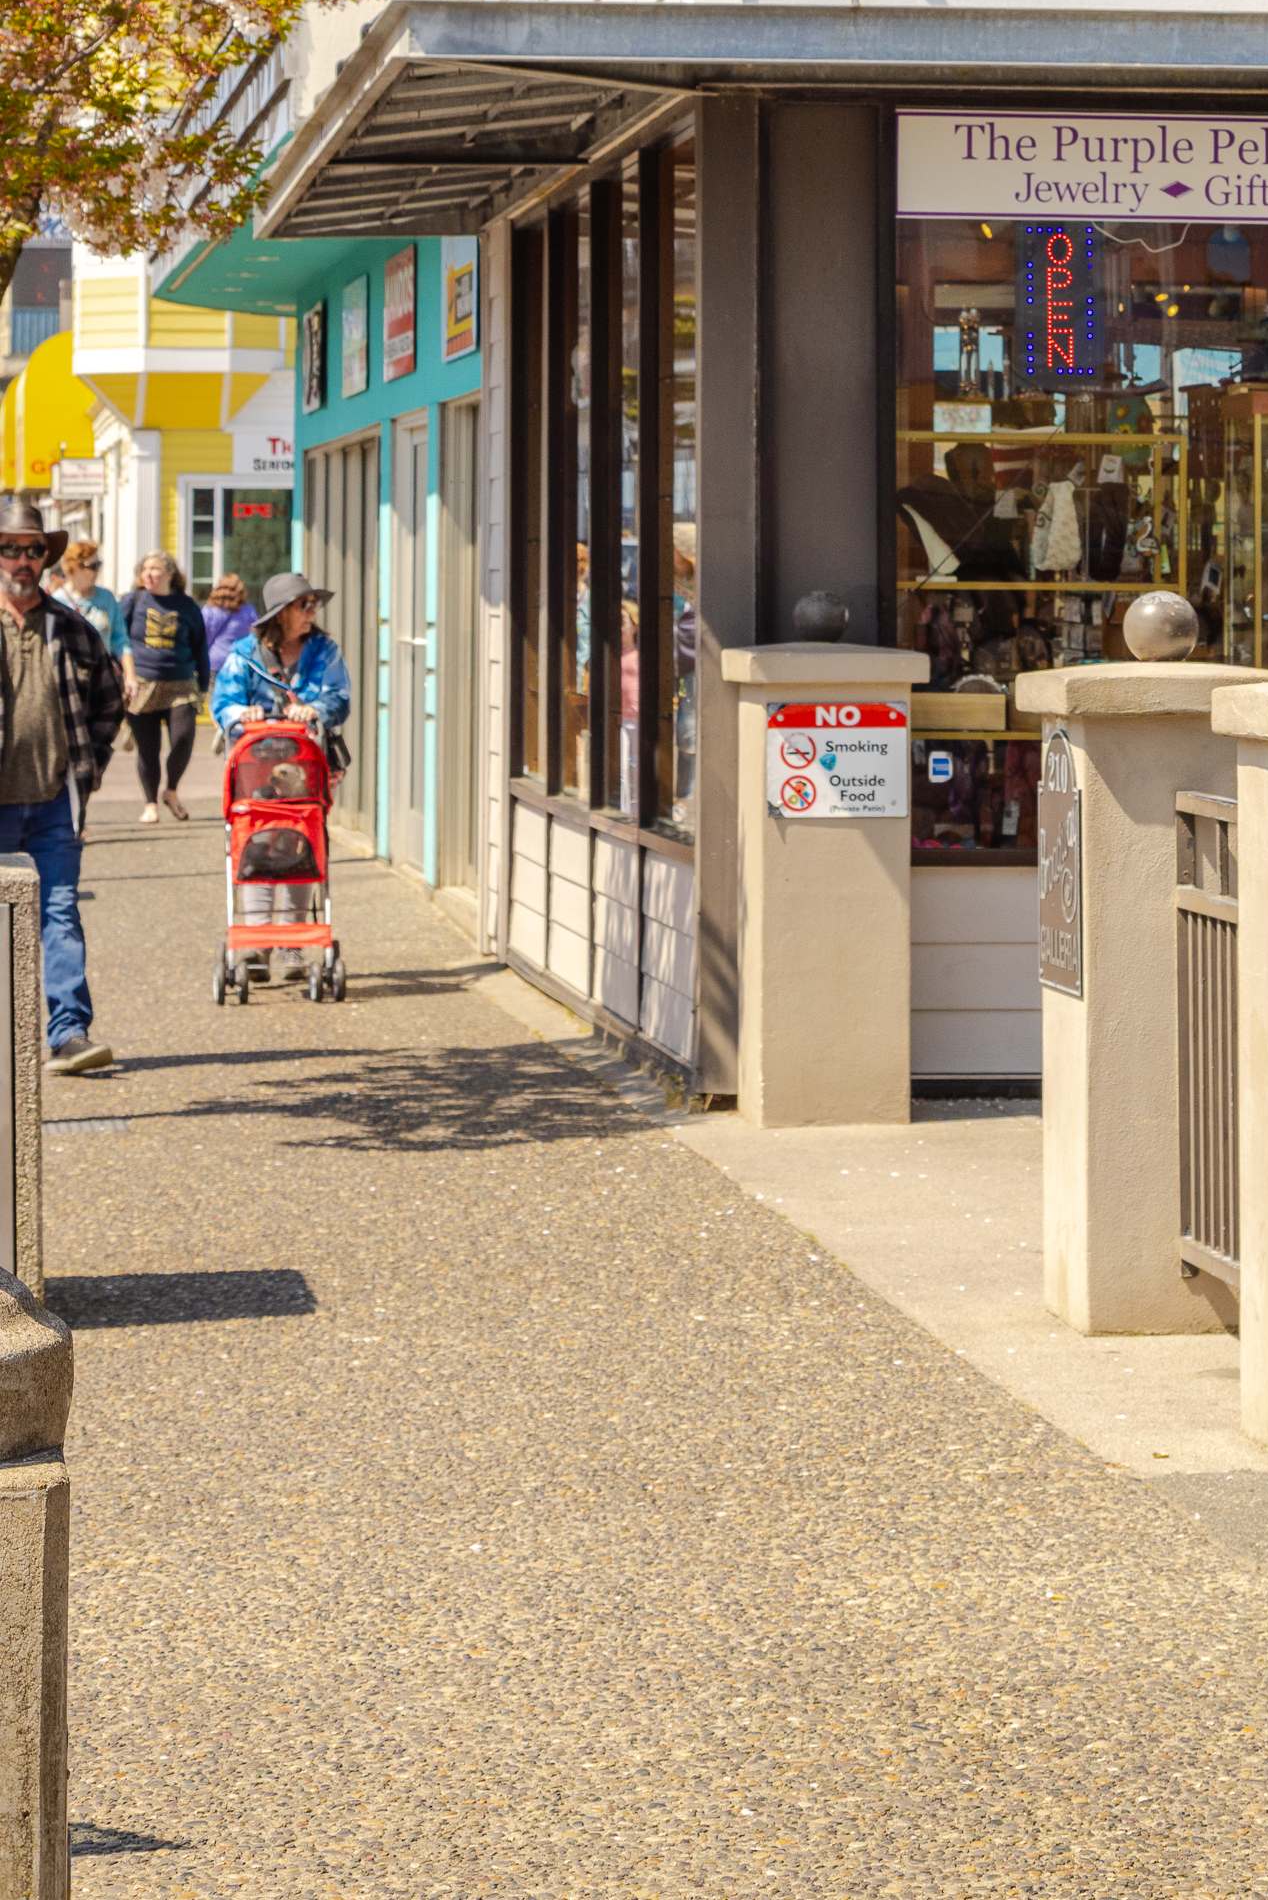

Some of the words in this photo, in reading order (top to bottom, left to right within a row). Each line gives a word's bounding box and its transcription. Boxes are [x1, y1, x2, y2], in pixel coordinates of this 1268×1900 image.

[954, 122, 1038, 163] The
[1052, 125, 1194, 174] Purple
[1014, 171, 1149, 213] Jewelry
[1046, 232, 1074, 368] OPEN
[815, 705, 861, 726] NO
[825, 740, 888, 756] Smoking
[829, 774, 886, 787] Outside
[1047, 752, 1068, 794] 210
[840, 790, 875, 802] Food
